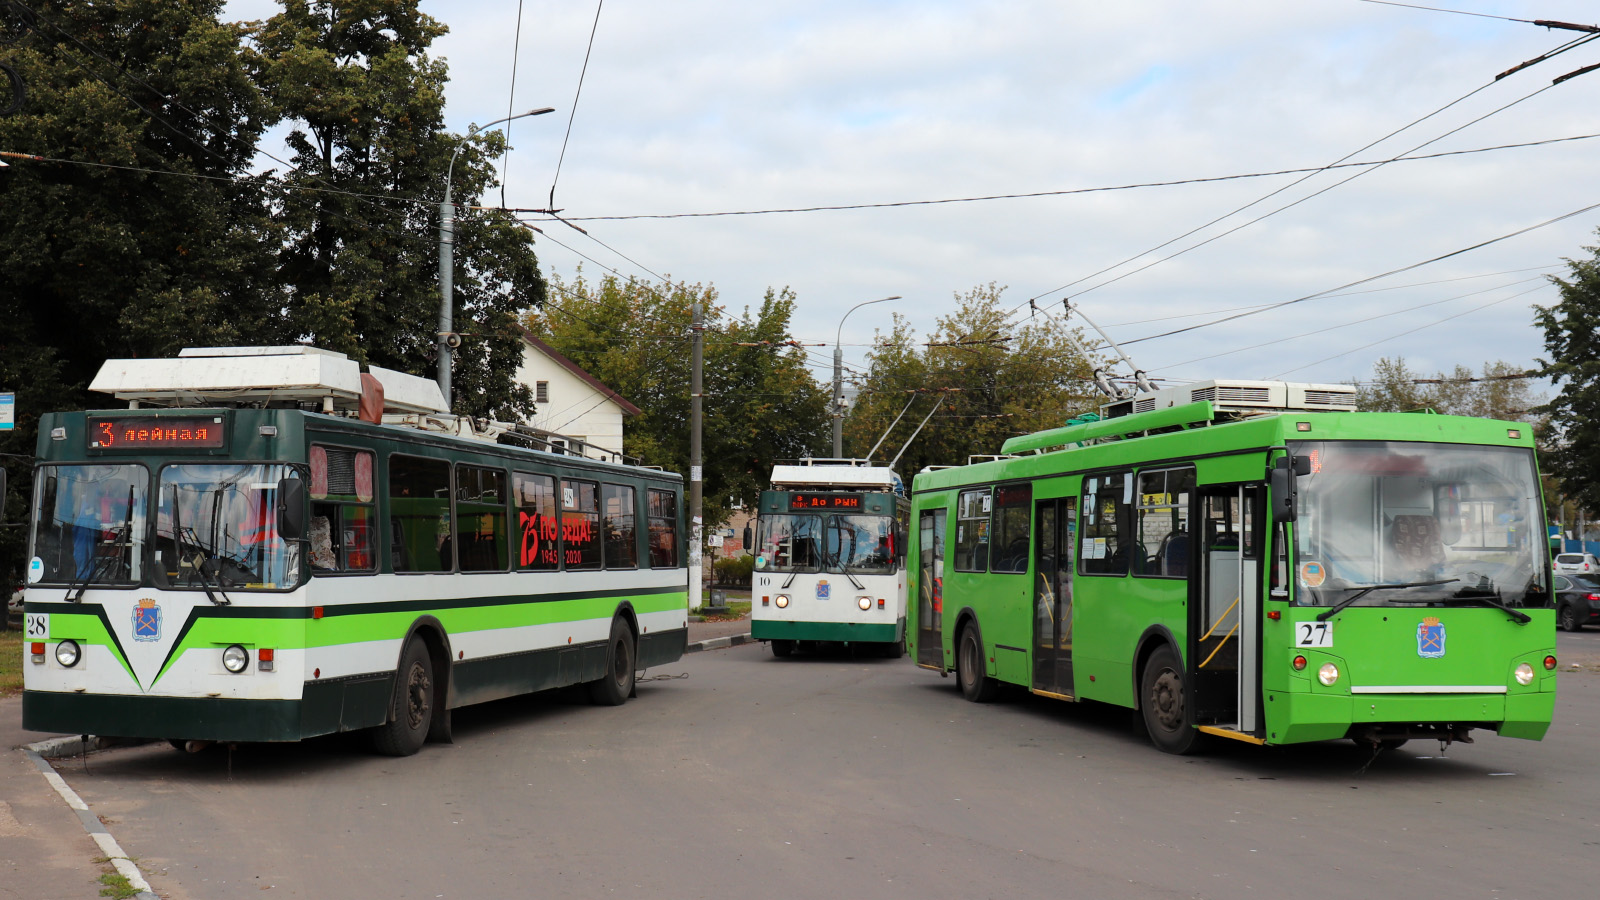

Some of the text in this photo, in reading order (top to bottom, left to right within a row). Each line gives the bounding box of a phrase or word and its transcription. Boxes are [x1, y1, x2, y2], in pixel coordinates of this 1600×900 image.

[99, 422, 208, 448] 3 лейная
[834, 498, 858, 507] РЫН
[759, 576, 771, 586] 10
[27, 615, 46, 635] 28
[1300, 623, 1328, 645] 27
